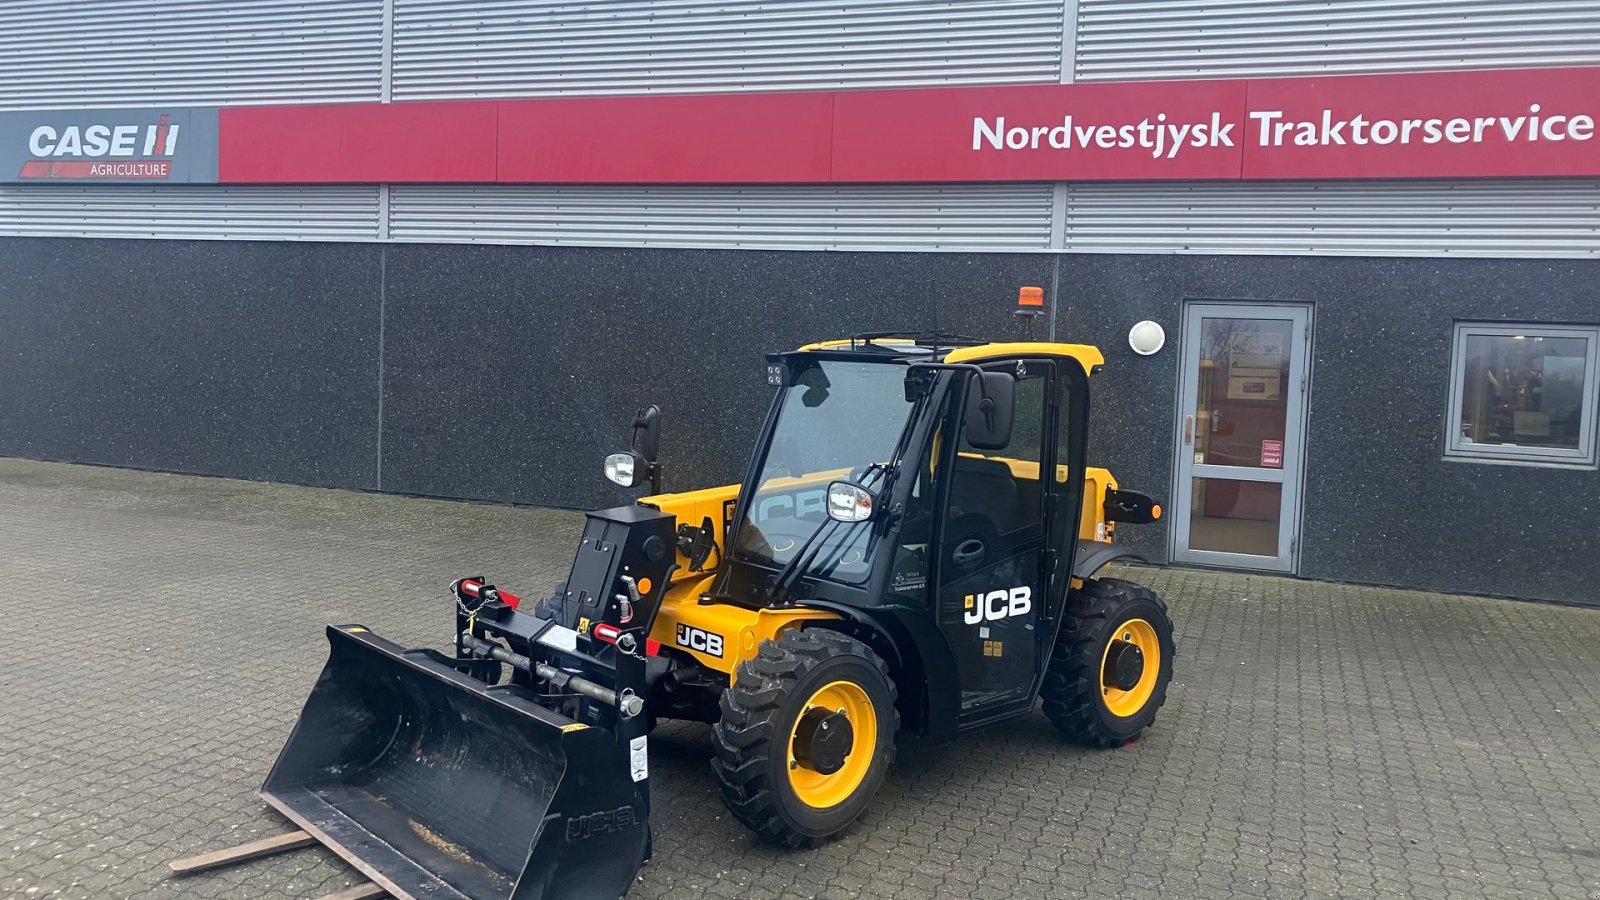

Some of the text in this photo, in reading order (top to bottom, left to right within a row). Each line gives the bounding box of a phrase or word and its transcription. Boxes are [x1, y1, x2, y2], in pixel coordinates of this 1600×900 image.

[29, 125, 138, 157] CASE
[972, 103, 1594, 159] Nordvestjysk Traktorservice
[90, 164, 167, 176] AGRICULTURE
[964, 586, 1031, 625] JCB
[677, 626, 723, 656] JCB
